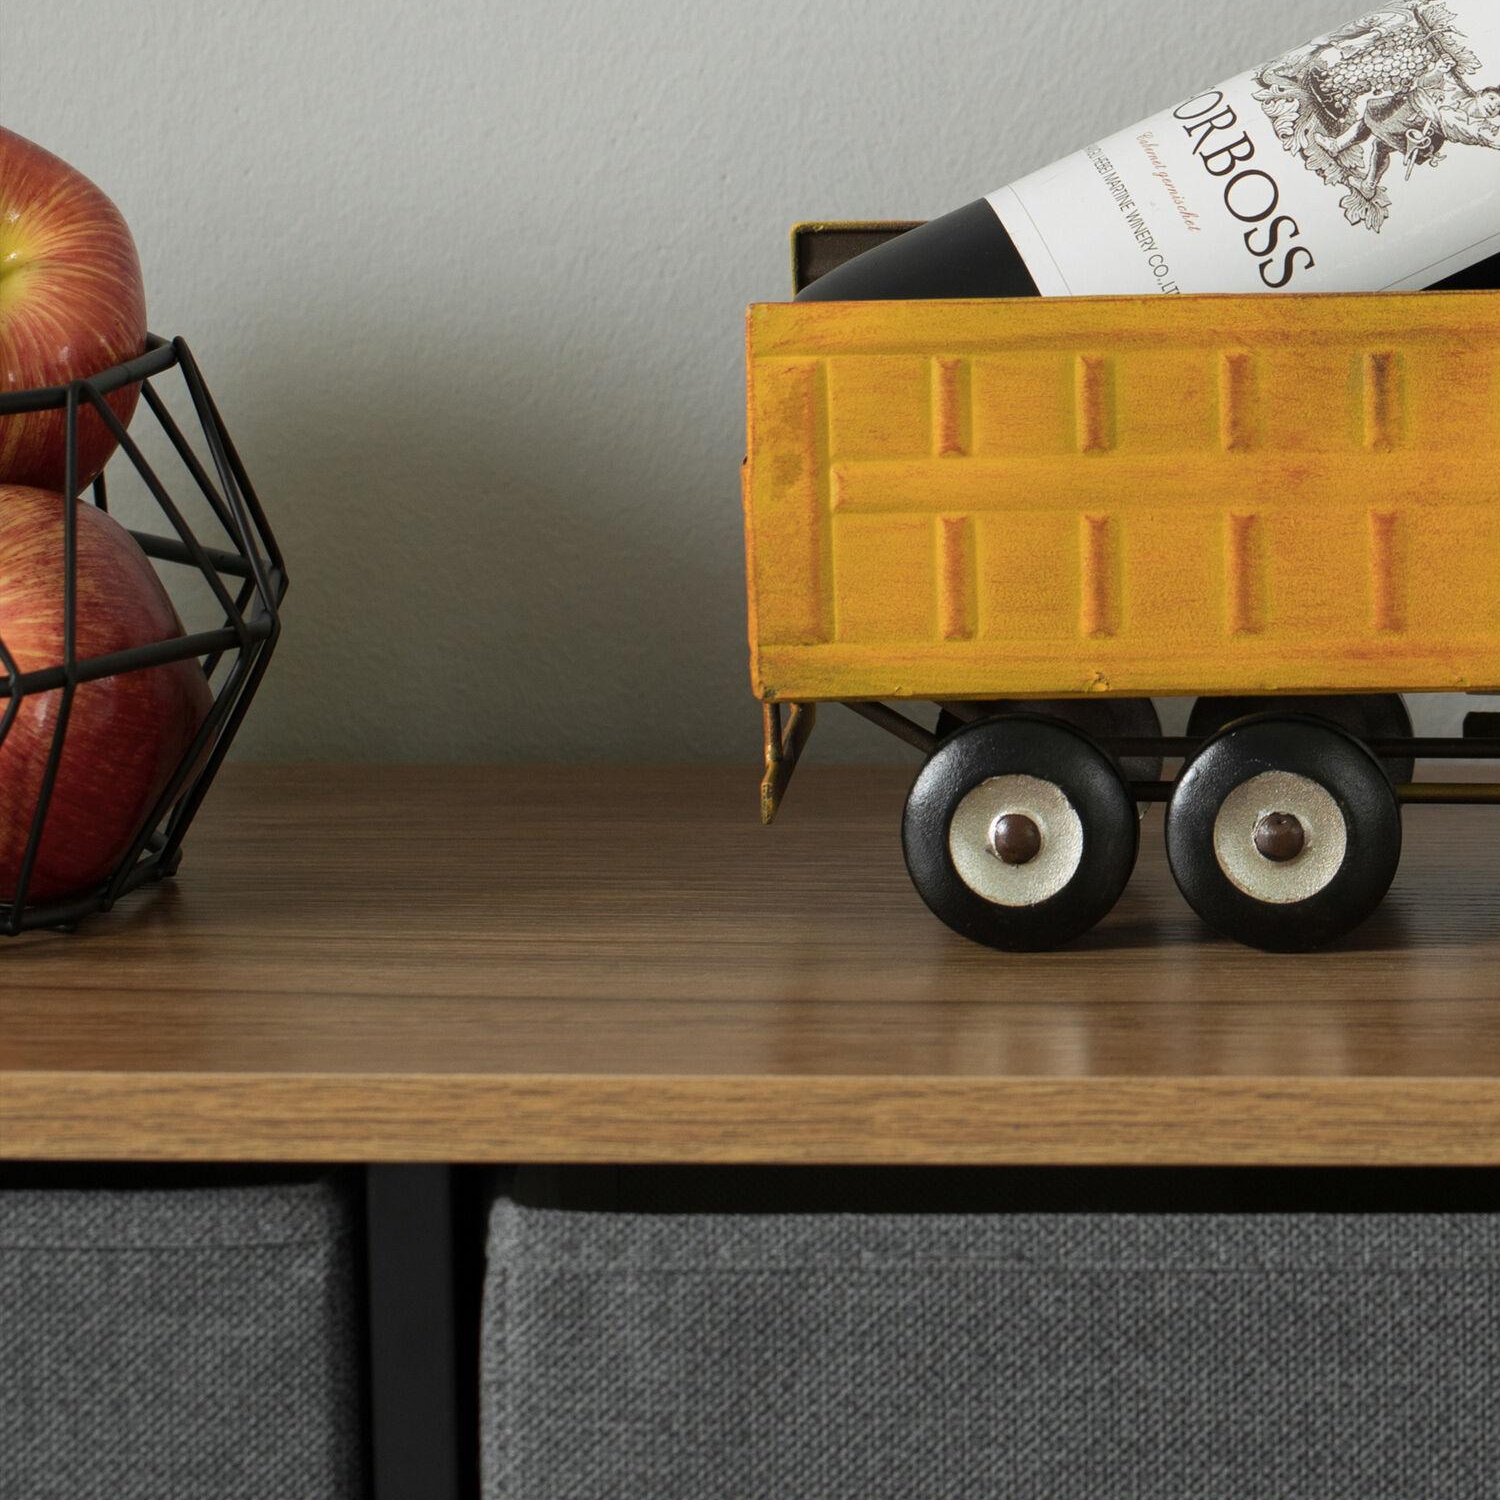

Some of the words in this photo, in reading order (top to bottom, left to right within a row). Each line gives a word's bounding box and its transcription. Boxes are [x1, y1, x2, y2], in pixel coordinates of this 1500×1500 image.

[1104, 172, 1135, 212] MARTINE
[1126, 209, 1158, 252] WINERY
[1173, 86, 1315, 288] ORBOSS
